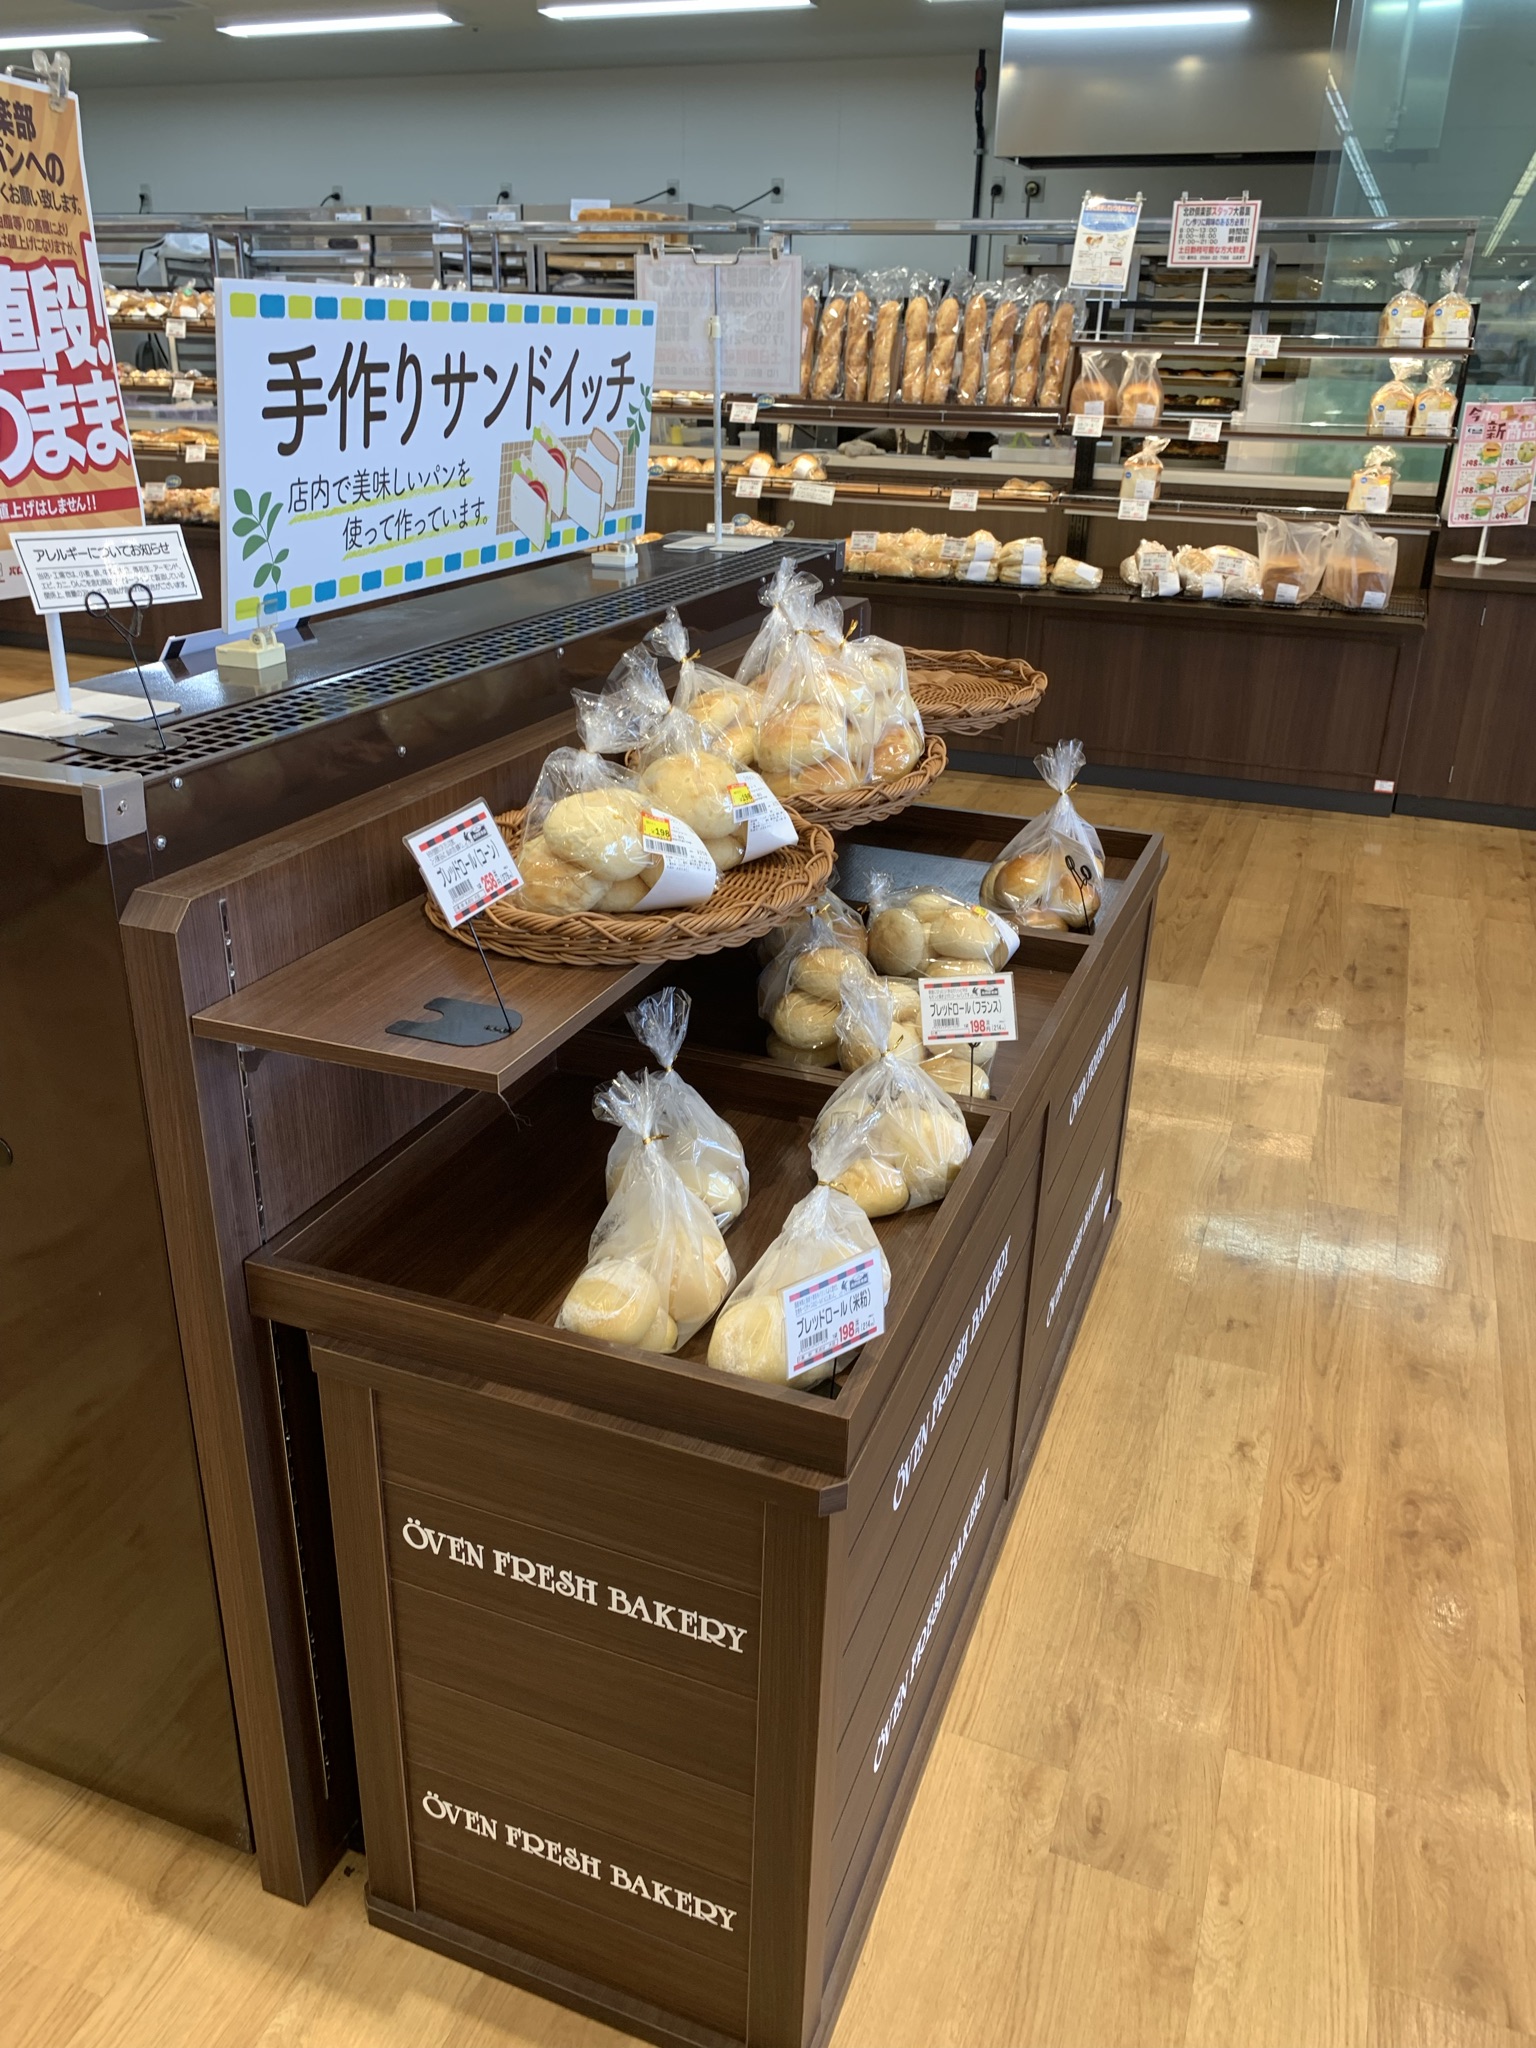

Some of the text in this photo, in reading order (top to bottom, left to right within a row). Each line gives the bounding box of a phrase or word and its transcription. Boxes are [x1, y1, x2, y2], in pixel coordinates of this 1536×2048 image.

[261, 341, 635, 456] 手作りサンドイッチ
[288, 458, 470, 514] 店内で美味しいパンを
[33, 542, 170, 562] アレルギーについてお知らせ
[342, 496, 488, 552] 使って作っています。
[970, 1019, 986, 1033] 198
[839, 1321, 855, 1342] 198
[493, 1549, 598, 1606] FRESH
[608, 1586, 748, 1654] BAKERY
[504, 1824, 602, 1880] FRESH
[609, 1864, 737, 1932] BAKERY
